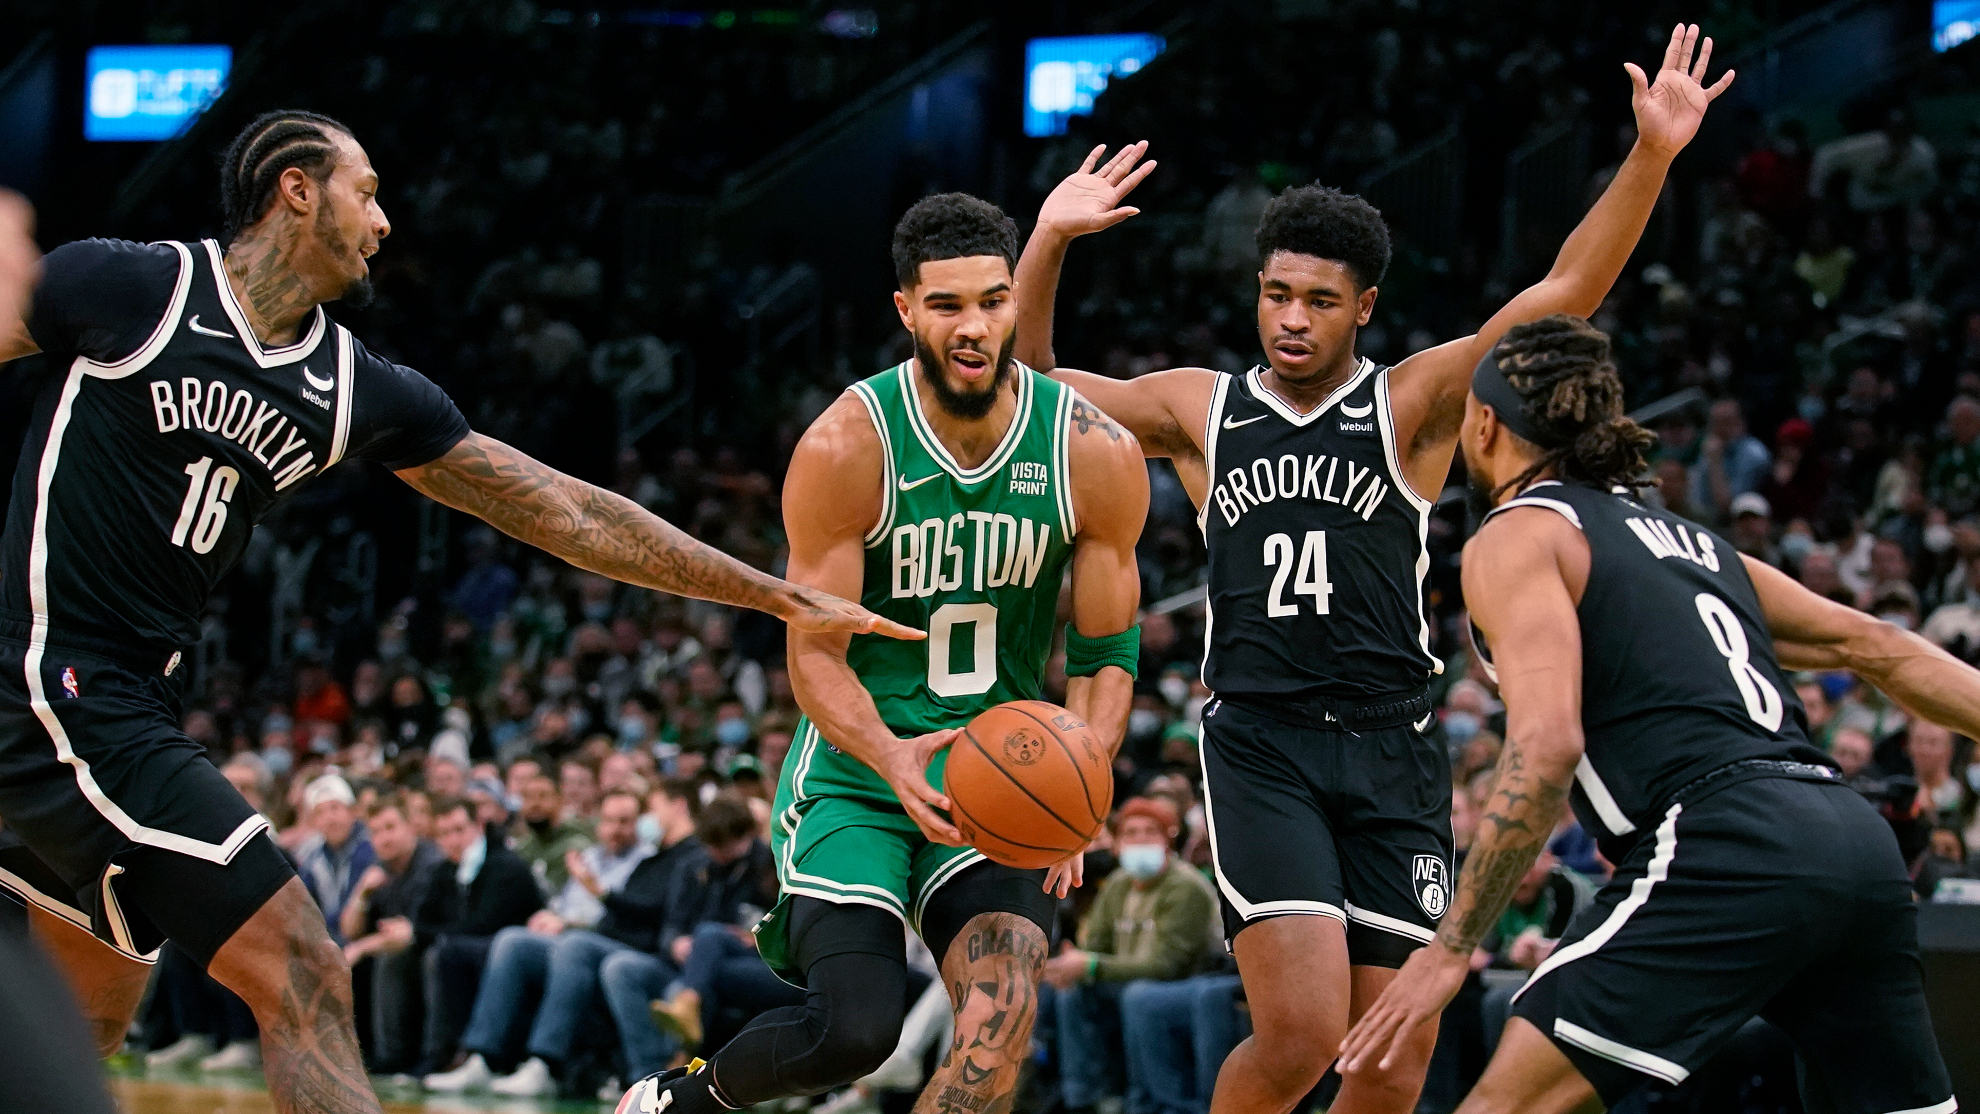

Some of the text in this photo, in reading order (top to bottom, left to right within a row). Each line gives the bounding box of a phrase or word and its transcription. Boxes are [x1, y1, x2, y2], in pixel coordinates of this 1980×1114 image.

[150, 377, 317, 492] BROOKLYN
[302, 387, 331, 411] Webull
[1339, 421, 1373, 432] Webull
[171, 455, 240, 555] 16
[1009, 480, 1048, 496] PRINT
[1010, 462, 1048, 482] VISTA
[1214, 454, 1389, 528] BROOKLYN
[891, 511, 1050, 599] BOSTON
[1263, 530, 1334, 618] 24
[927, 602, 999, 698] 0
[1694, 592, 1784, 733] 8
[1415, 858, 1449, 894] NETS
